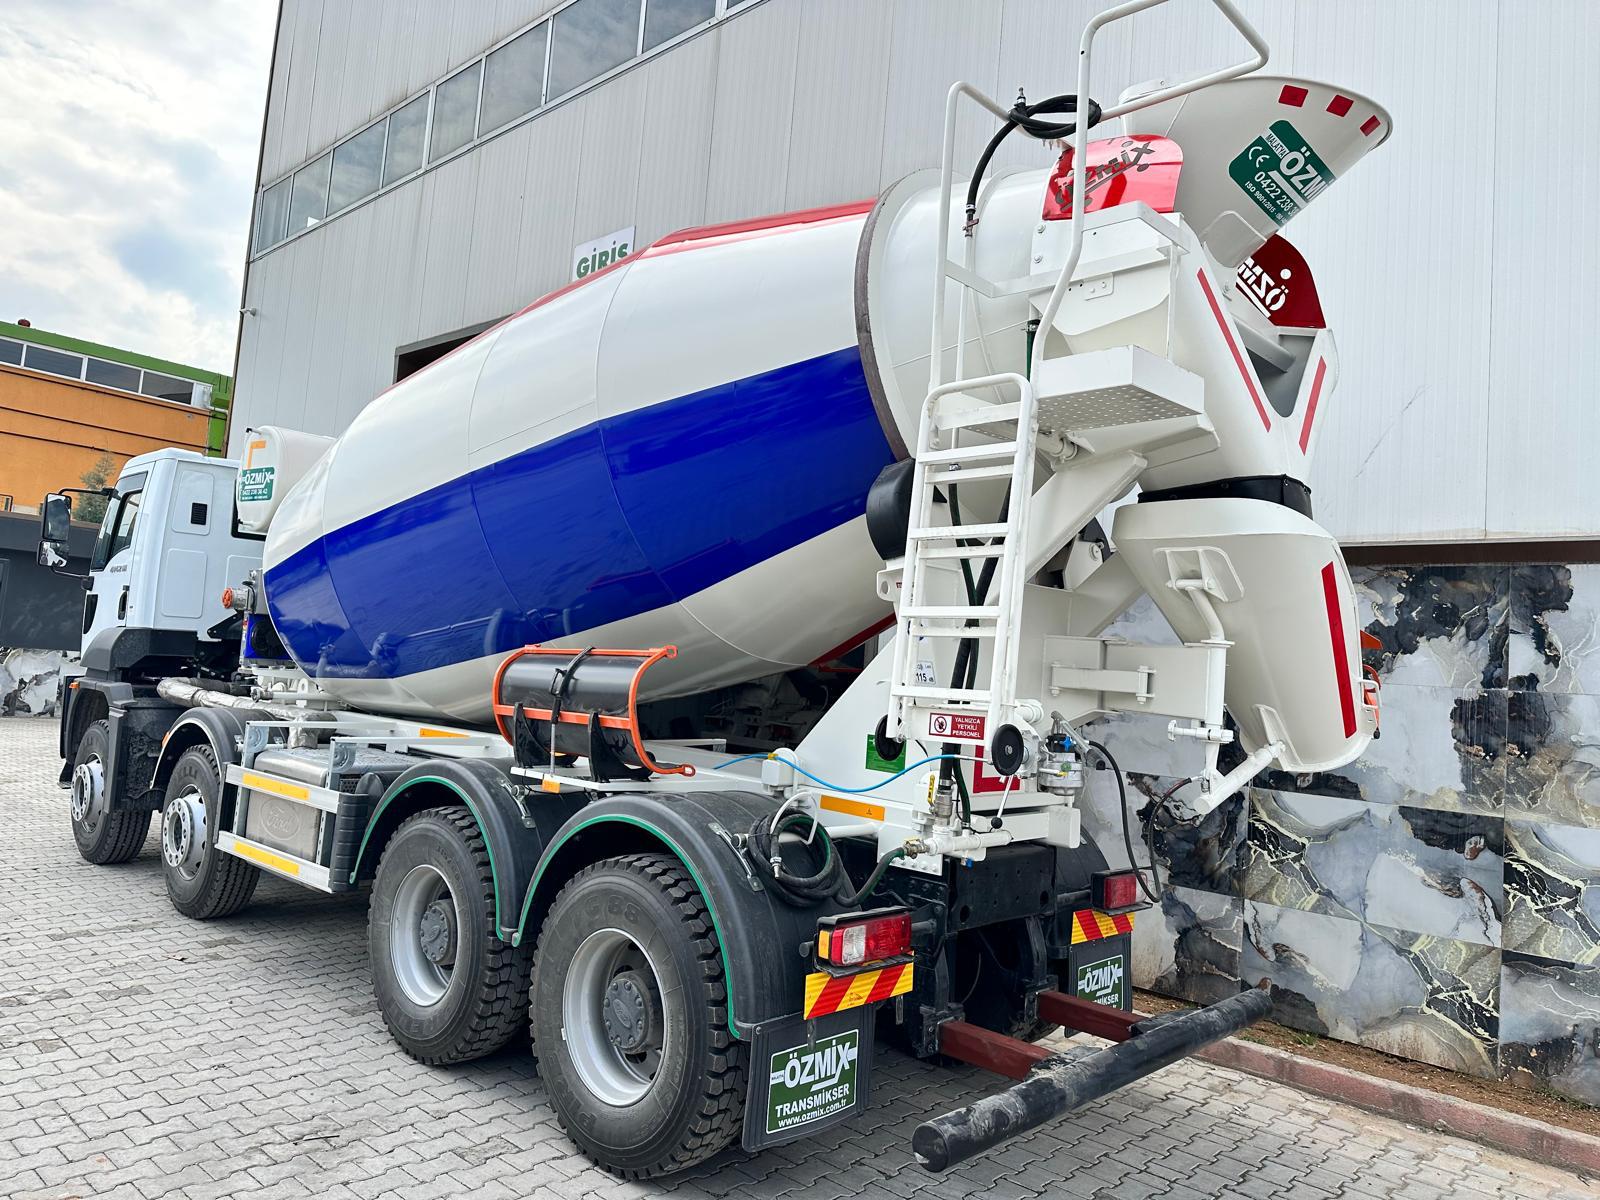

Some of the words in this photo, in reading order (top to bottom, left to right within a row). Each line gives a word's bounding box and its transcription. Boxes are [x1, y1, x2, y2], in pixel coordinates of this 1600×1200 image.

[1245, 181, 1257, 193] ISO
[1254, 171, 1281, 199] 0422
[245, 469, 271, 484] ÖZMİX
[916, 672, 927, 682] 115
[952, 729, 981, 737] PERSONEL
[1085, 960, 1119, 993] ÖZMİX
[784, 1040, 850, 1089] ÖZMİX
[775, 1083, 850, 1118] TRANSMİKSER
[778, 1099, 847, 1128] www.ozmix.com.tr
